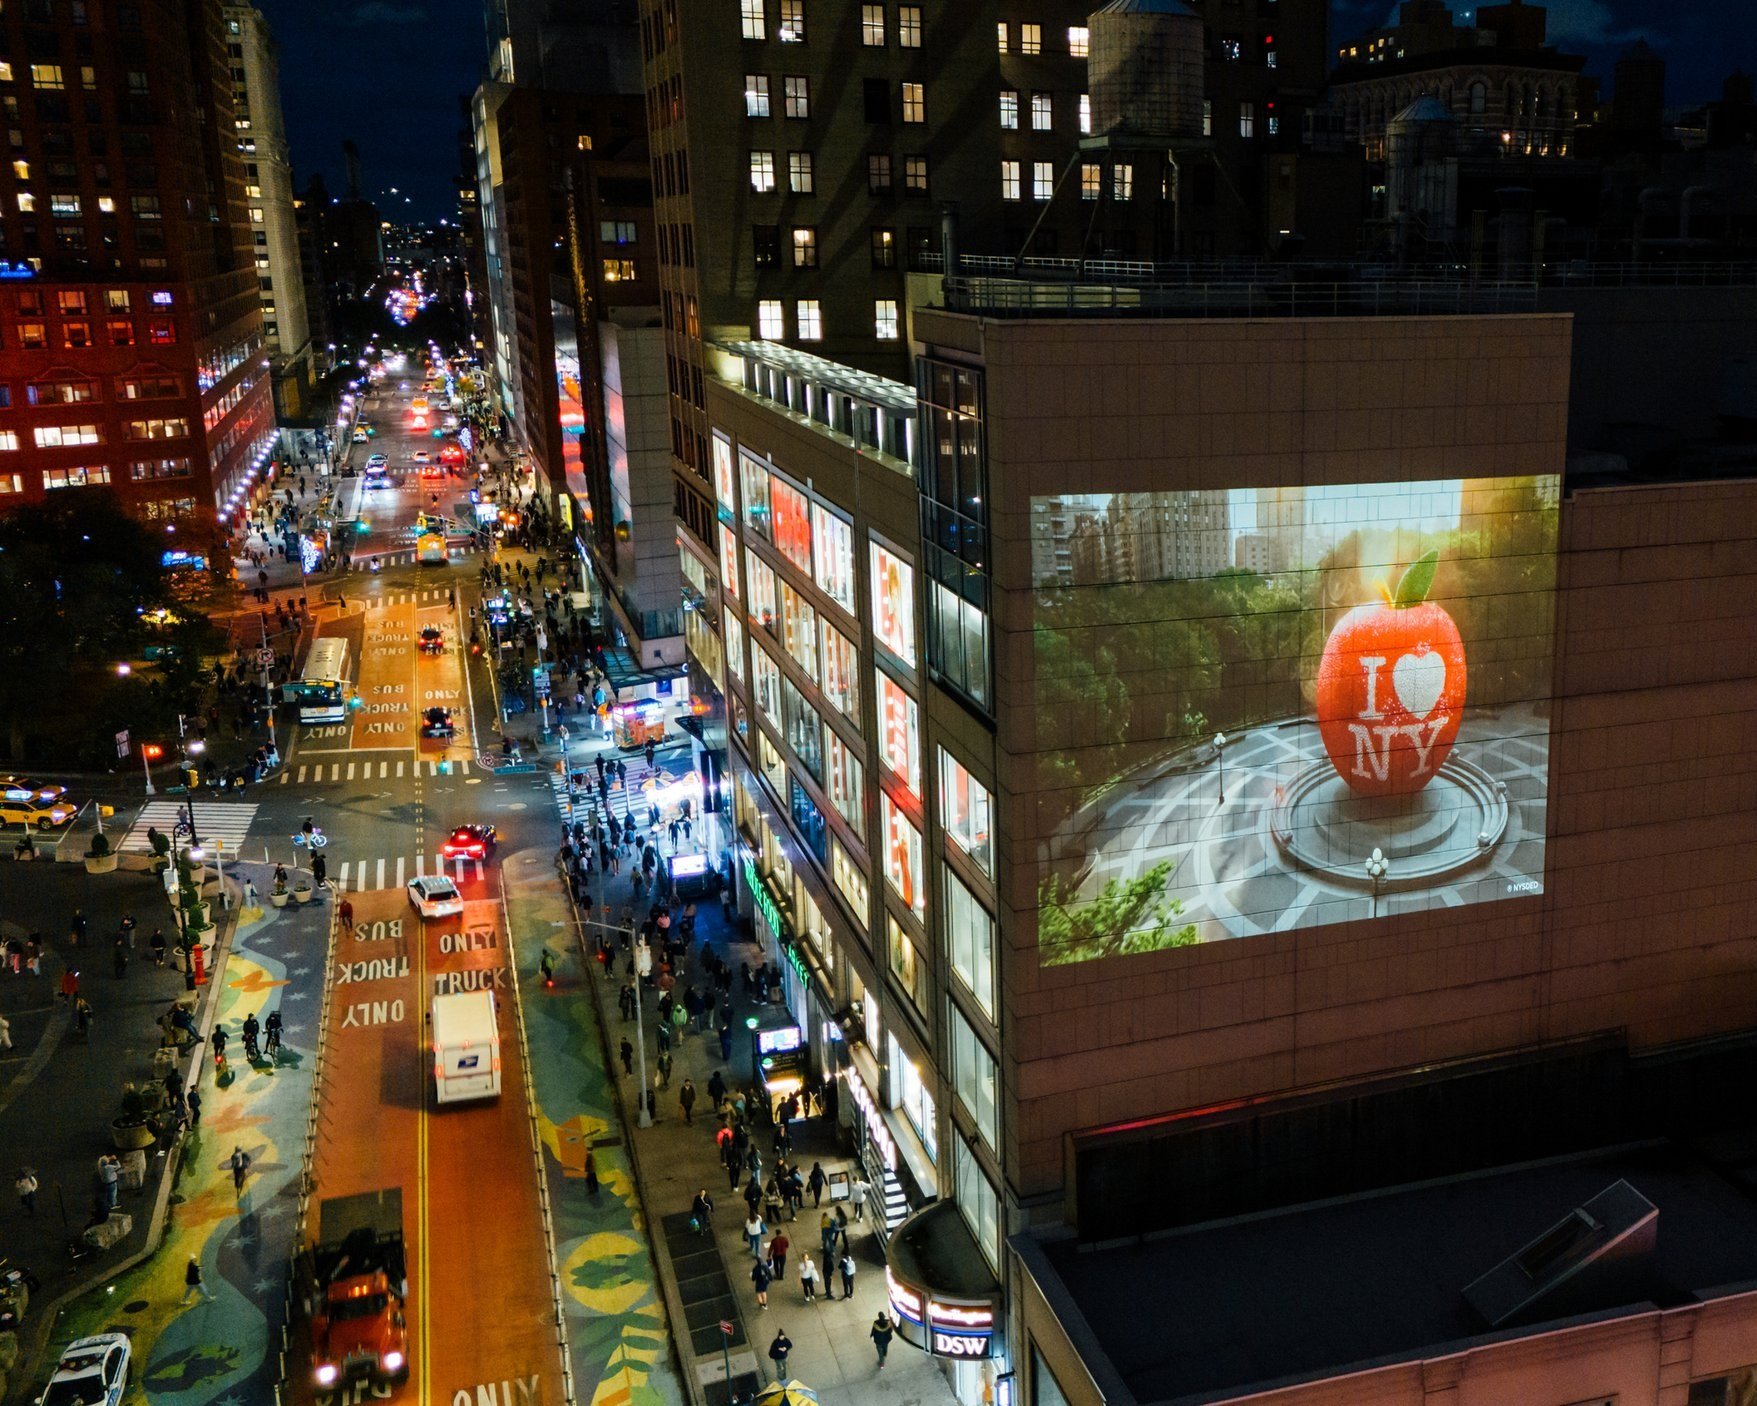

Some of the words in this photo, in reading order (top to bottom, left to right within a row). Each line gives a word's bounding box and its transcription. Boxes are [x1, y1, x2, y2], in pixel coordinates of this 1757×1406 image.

[373, 684, 404, 694] BUS
[425, 690, 460, 699] ONLY
[1358, 656, 1387, 720] I
[360, 702, 409, 714] TRUCK
[304, 726, 347, 740] ONLY
[364, 722, 405, 734] ONLY
[1348, 716, 1449, 782] NY
[1513, 880, 1539, 892] NYSDED
[355, 919, 403, 942] BUS
[440, 931, 495, 954] ONLY
[337, 956, 410, 985] TRUCK
[435, 967, 506, 995] TRUCK
[341, 999, 405, 1029] ONLY
[936, 1333, 987, 1355] DSW
